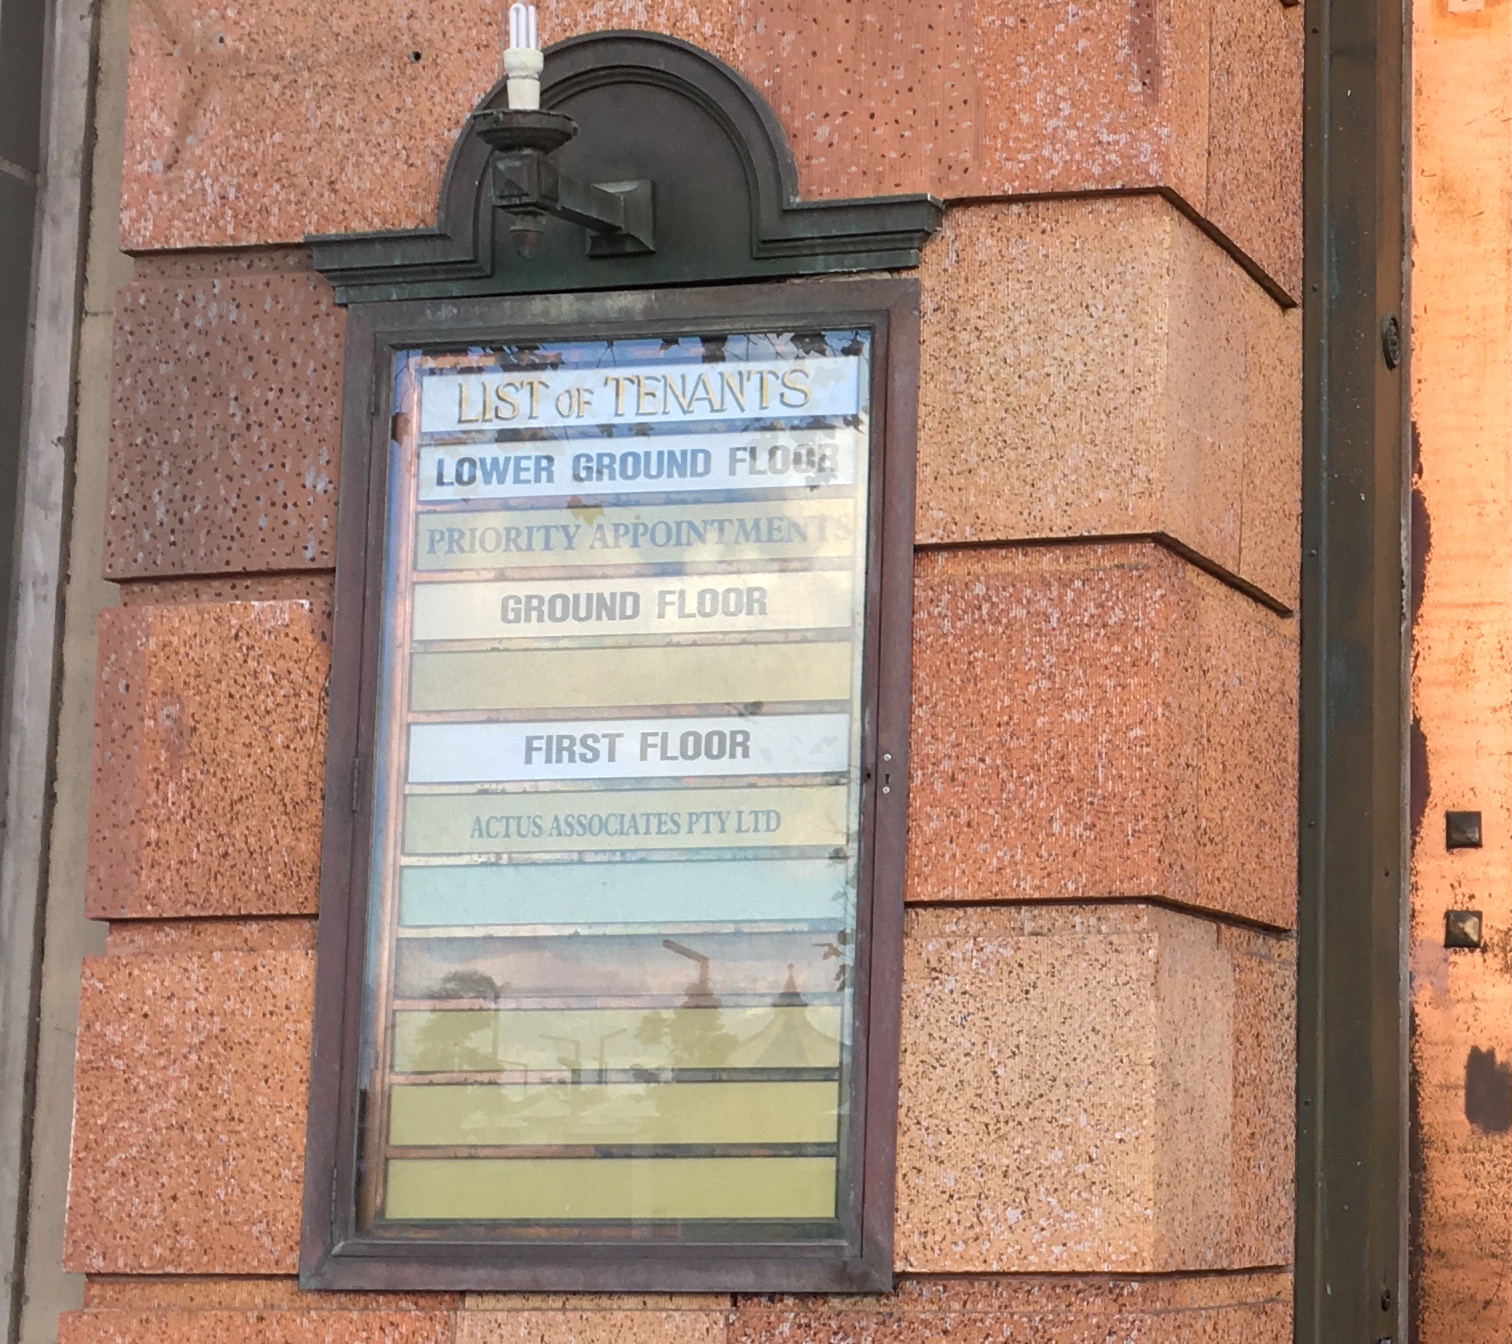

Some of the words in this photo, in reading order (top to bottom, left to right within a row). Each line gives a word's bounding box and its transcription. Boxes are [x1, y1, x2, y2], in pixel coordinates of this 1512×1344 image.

[457, 378, 549, 424] LIST
[555, 387, 595, 419] OF
[603, 367, 812, 416] TENANTS
[436, 454, 555, 487] LOWER
[571, 447, 712, 483] GROUND
[728, 441, 840, 477] FLOOR
[426, 522, 582, 555] PRIORITY
[589, 513, 856, 551] APPOINTMENTS
[500, 590, 641, 624] GROUND
[656, 586, 768, 619] FLOOR
[524, 732, 624, 765] FIRST
[639, 729, 751, 762] FLOOR
[470, 814, 544, 839] ACTUS
[548, 811, 682, 837] ASSOCIATES
[687, 810, 732, 835] PTY
[735, 808, 782, 834] LTD
